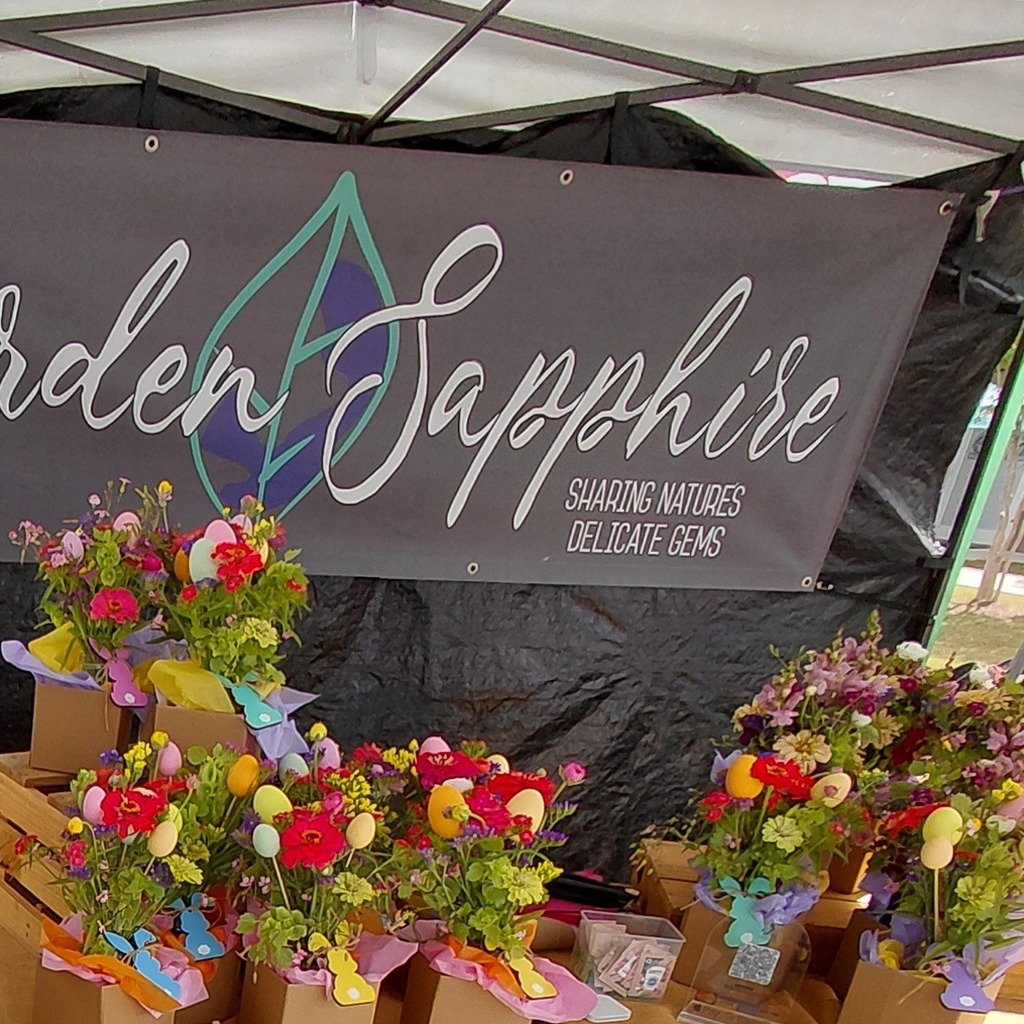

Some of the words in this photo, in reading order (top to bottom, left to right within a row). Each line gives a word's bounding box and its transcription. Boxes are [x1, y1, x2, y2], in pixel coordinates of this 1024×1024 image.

[322, 223, 847, 530] Sapphire
[564, 477, 656, 514] SHARING
[566, 520, 668, 556] DELICATE
[668, 524, 726, 559] GEMS
